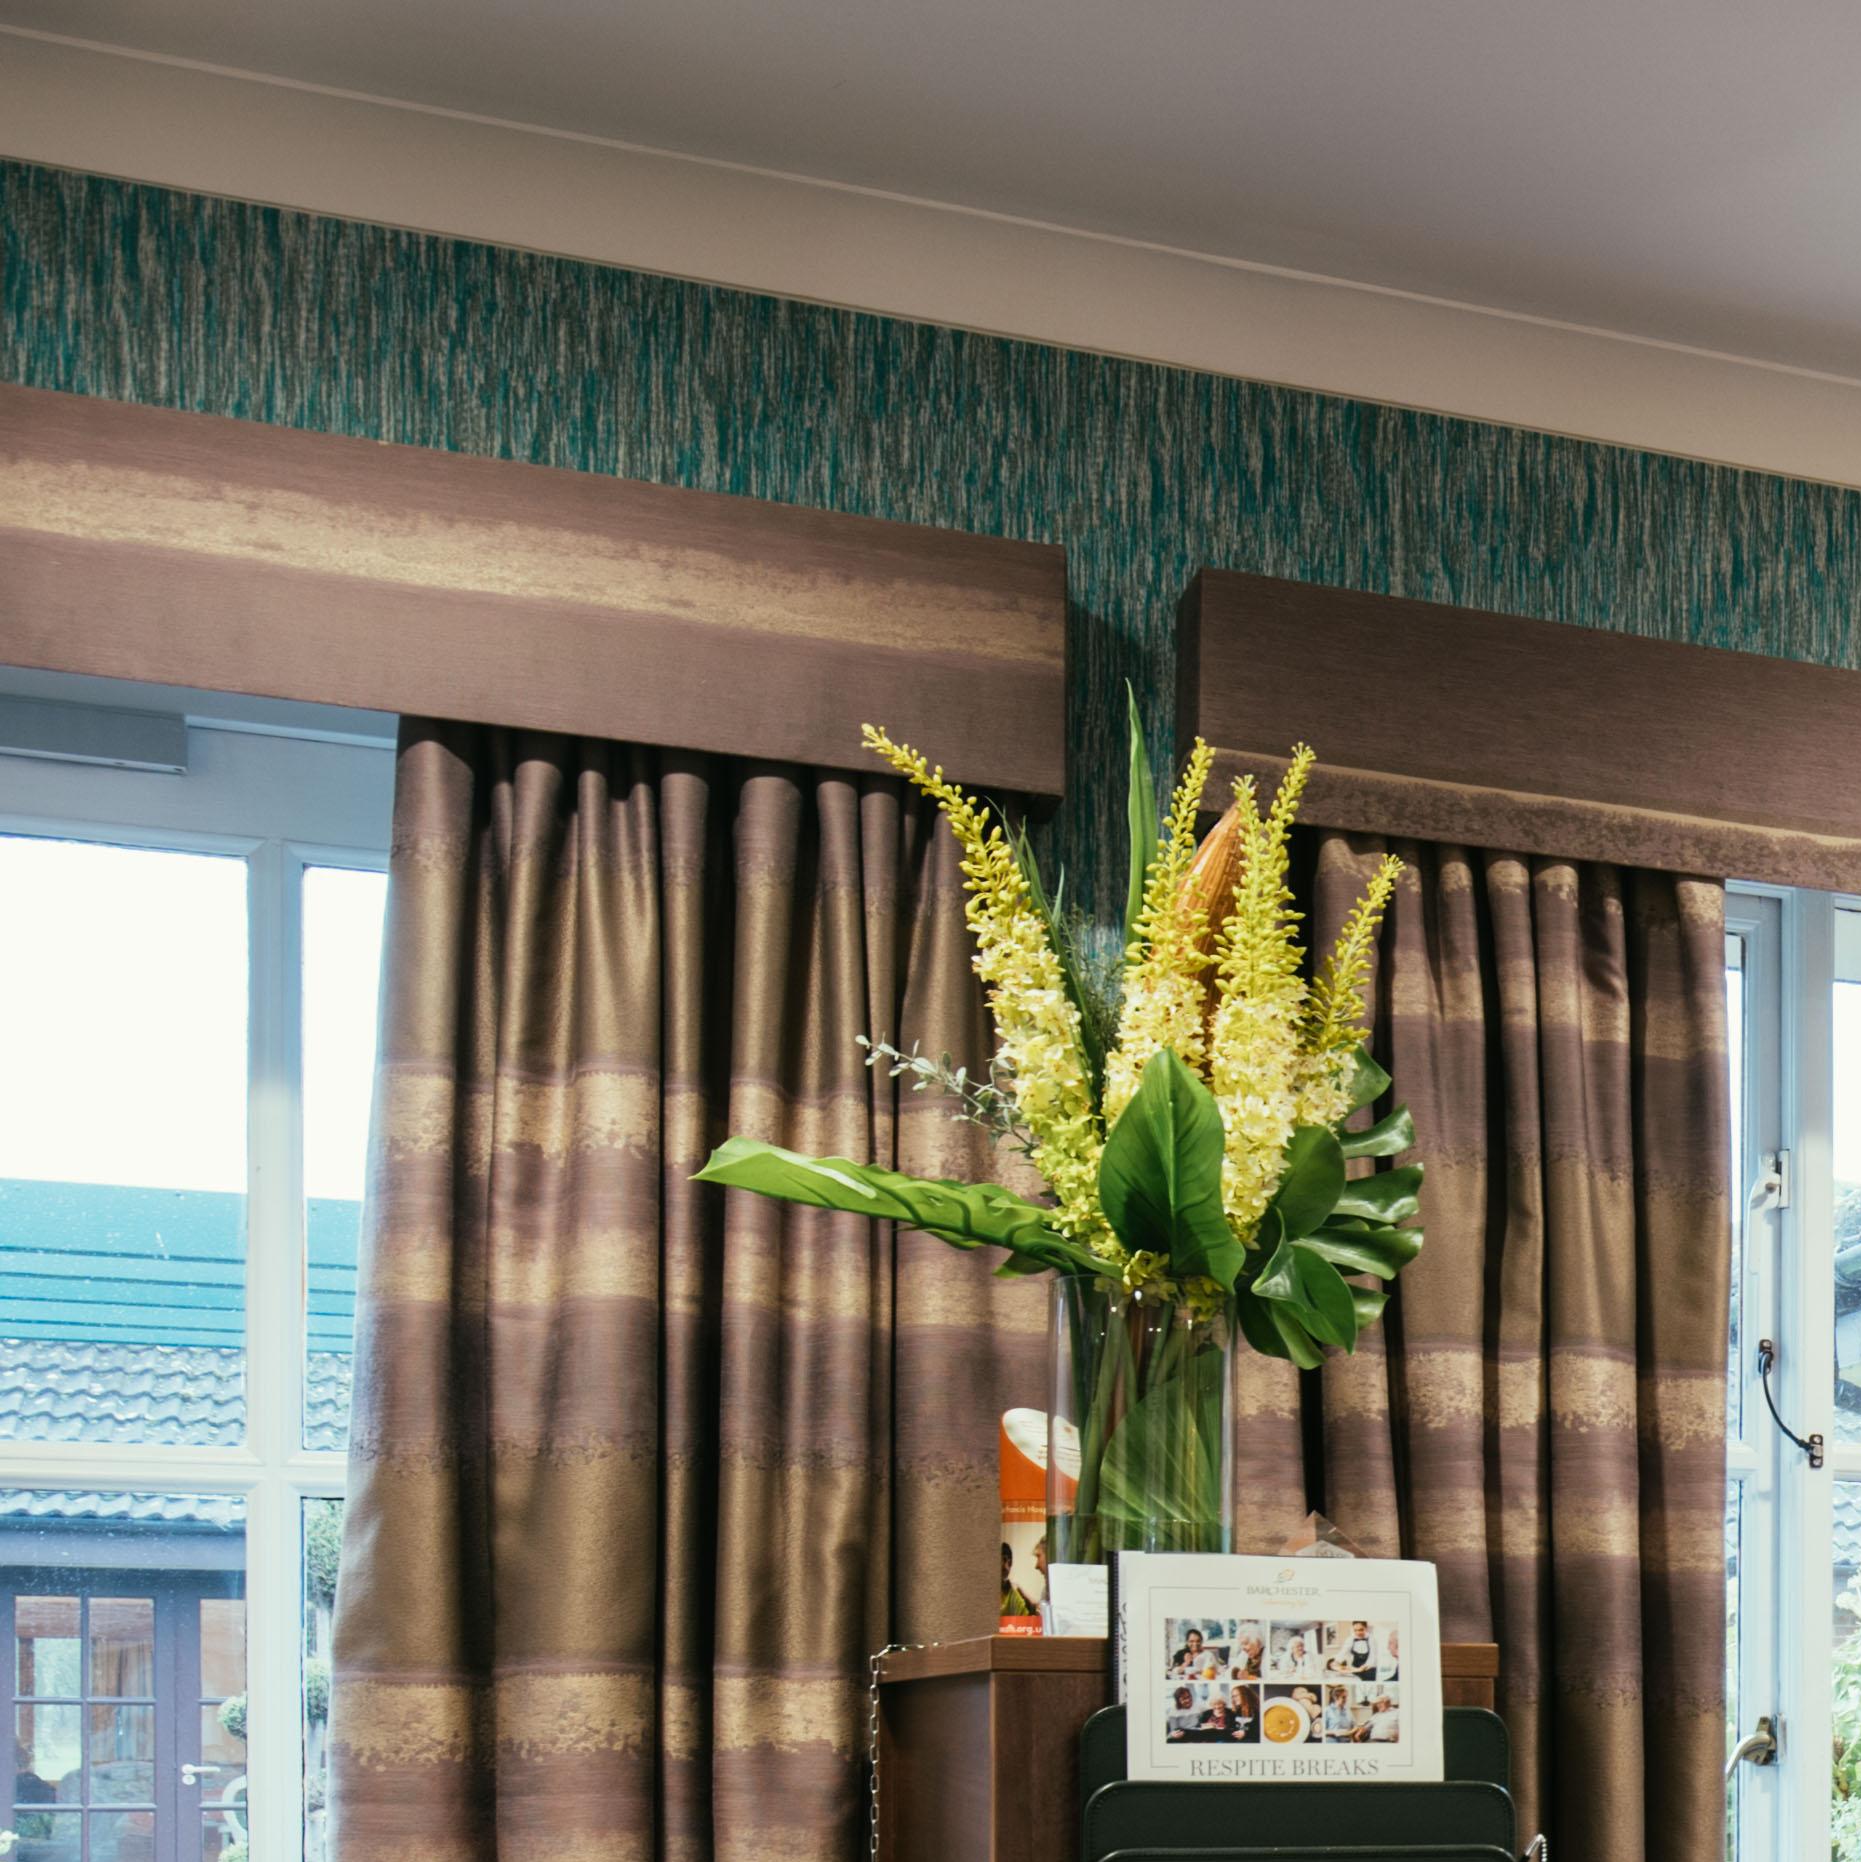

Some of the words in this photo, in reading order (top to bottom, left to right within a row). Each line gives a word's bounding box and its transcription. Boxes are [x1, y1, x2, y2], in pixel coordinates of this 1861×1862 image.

[1246, 1585, 1320, 1598] BARCHESTER
[1189, 1758, 1286, 1777] RESPITE
[1292, 1758, 1380, 1777] BREAKS
